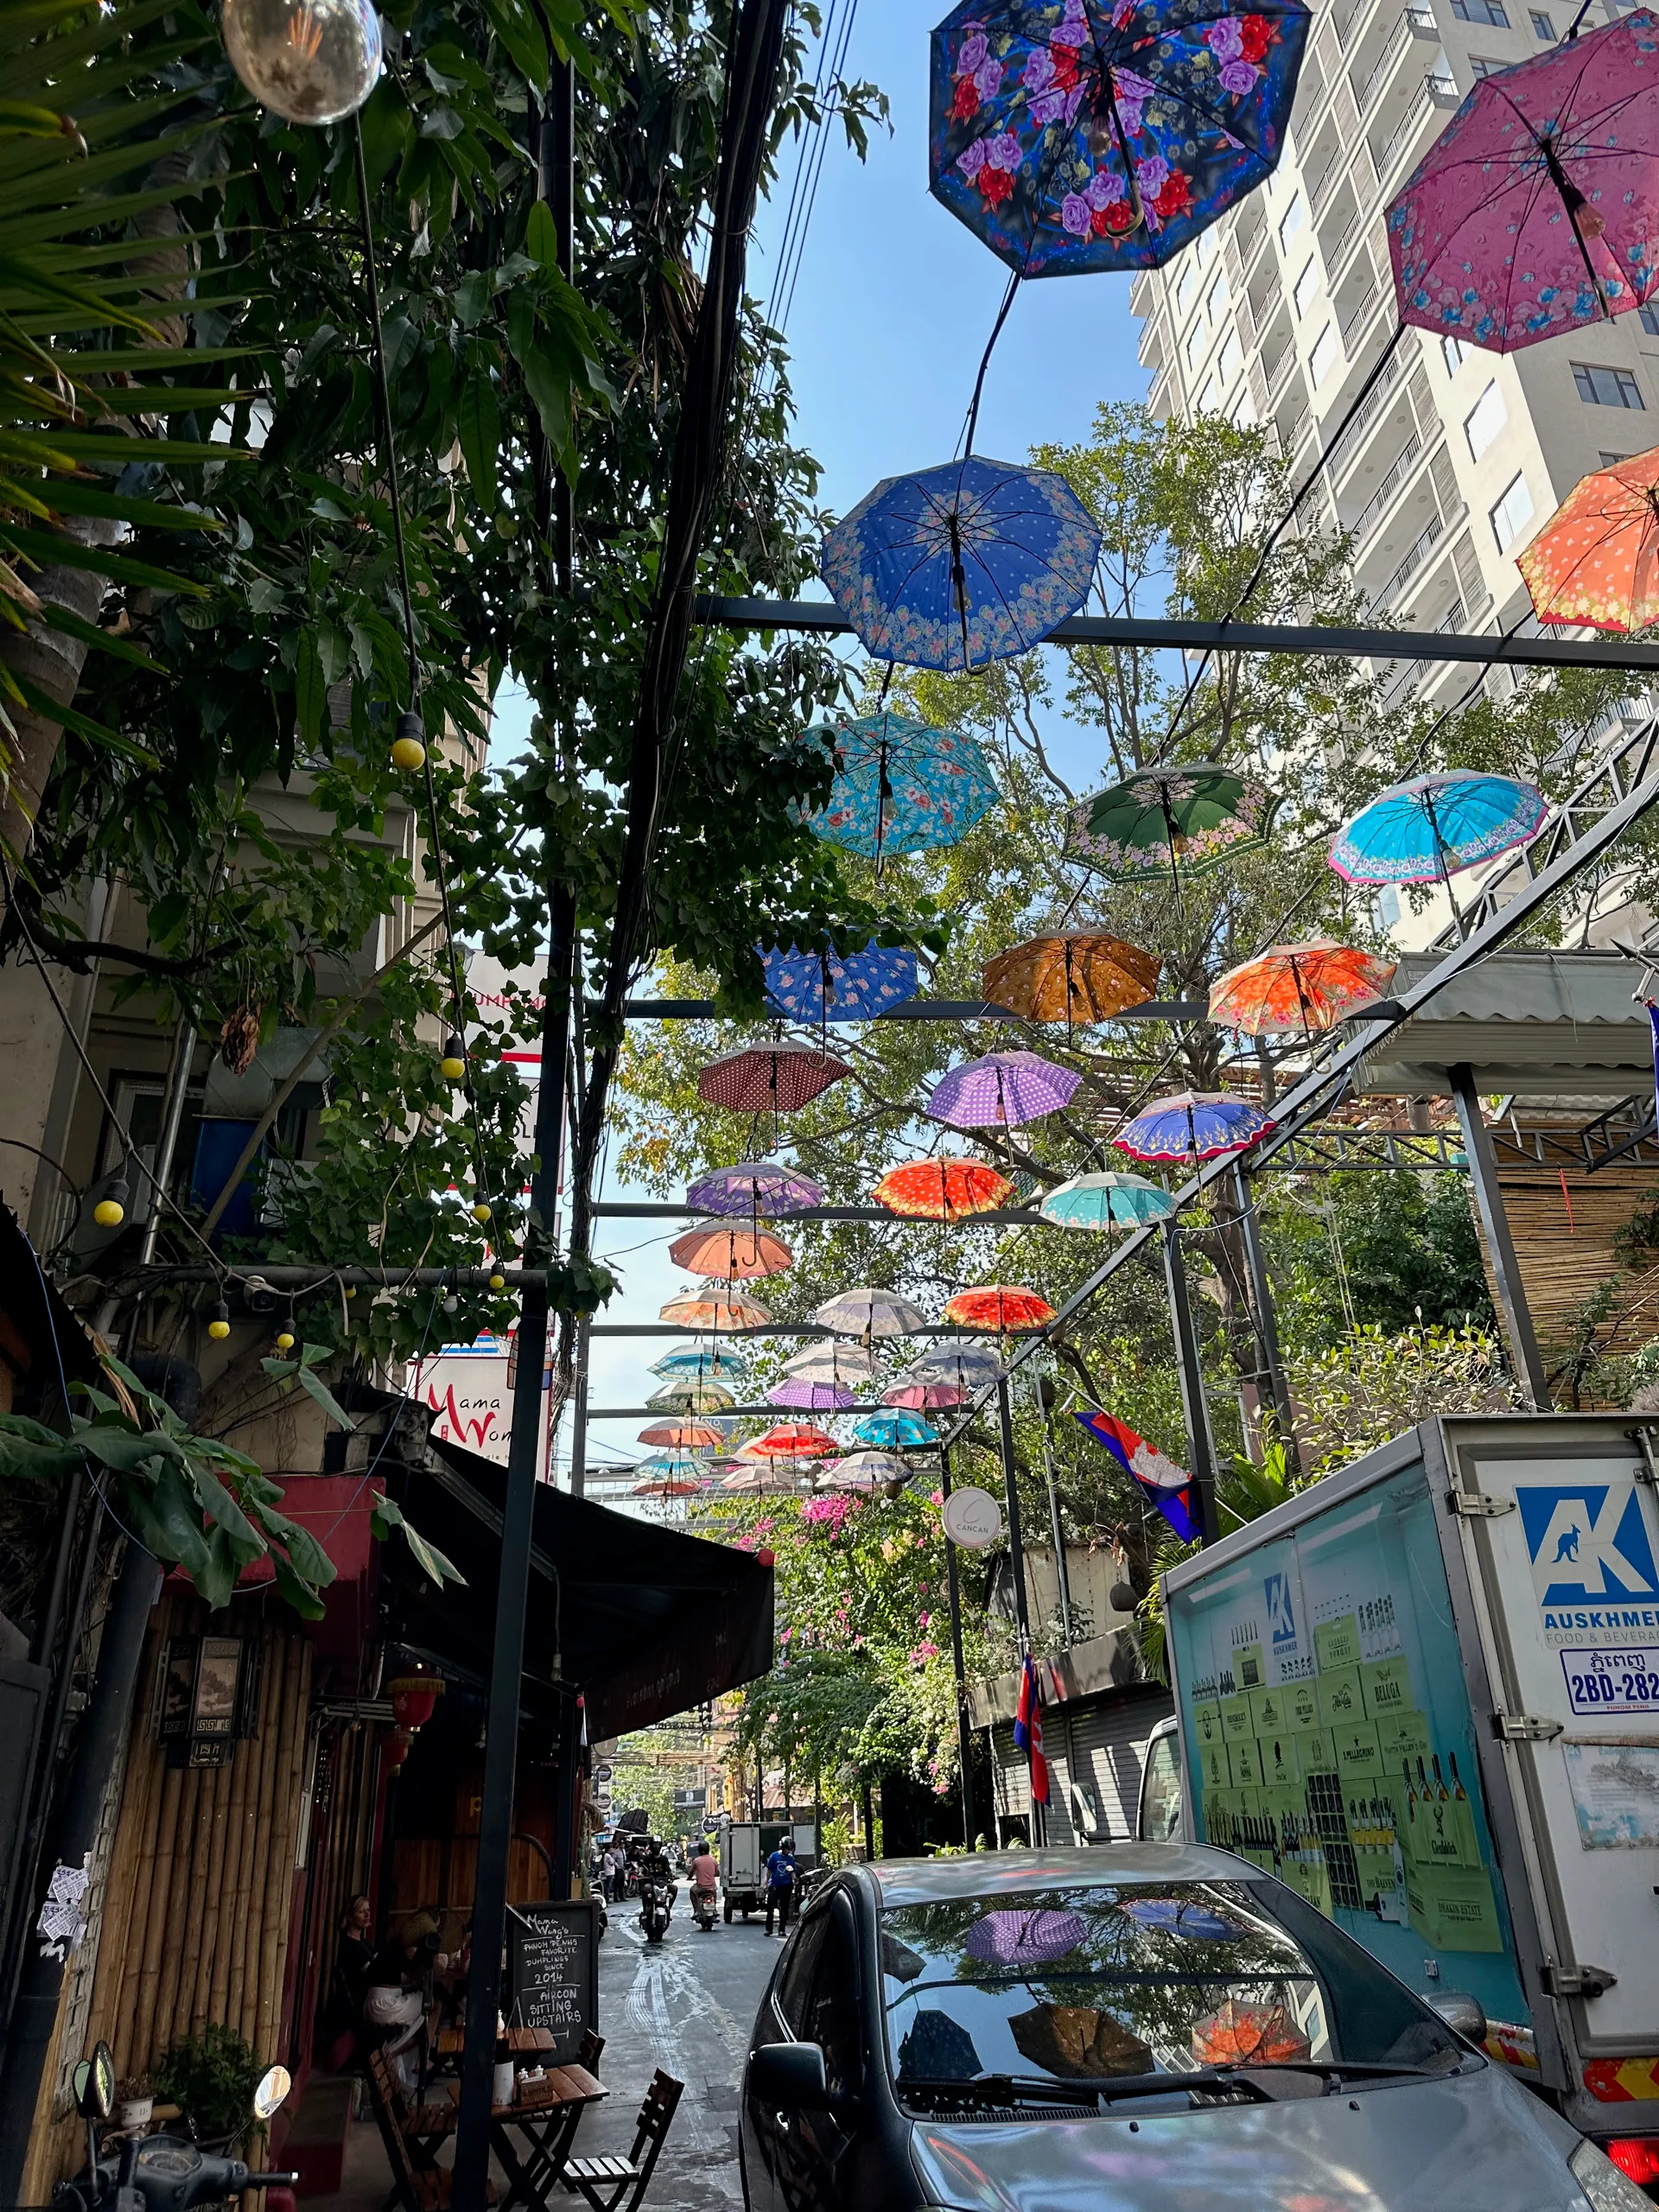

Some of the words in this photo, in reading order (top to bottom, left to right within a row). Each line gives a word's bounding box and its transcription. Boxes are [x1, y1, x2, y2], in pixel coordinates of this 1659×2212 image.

[427, 1382, 500, 1443] Mama
[464, 1411, 512, 1448] Won
[956, 1523, 989, 1534] CANCAN
[1546, 1632, 1583, 1644] FOOD
[1590, 1632, 1599, 1643] &
[1374, 1681, 1402, 1702] BELUGA
[1375, 1876, 1395, 1890] BALVEN
[1460, 1904, 1483, 1916] ESTATE
[550, 1938, 577, 1947] PENHS
[541, 1946, 577, 1956] FAVORITE
[525, 1955, 569, 1967] DUMPLINGS
[544, 1962, 564, 1971] SINCE
[534, 1971, 563, 1985] 2014
